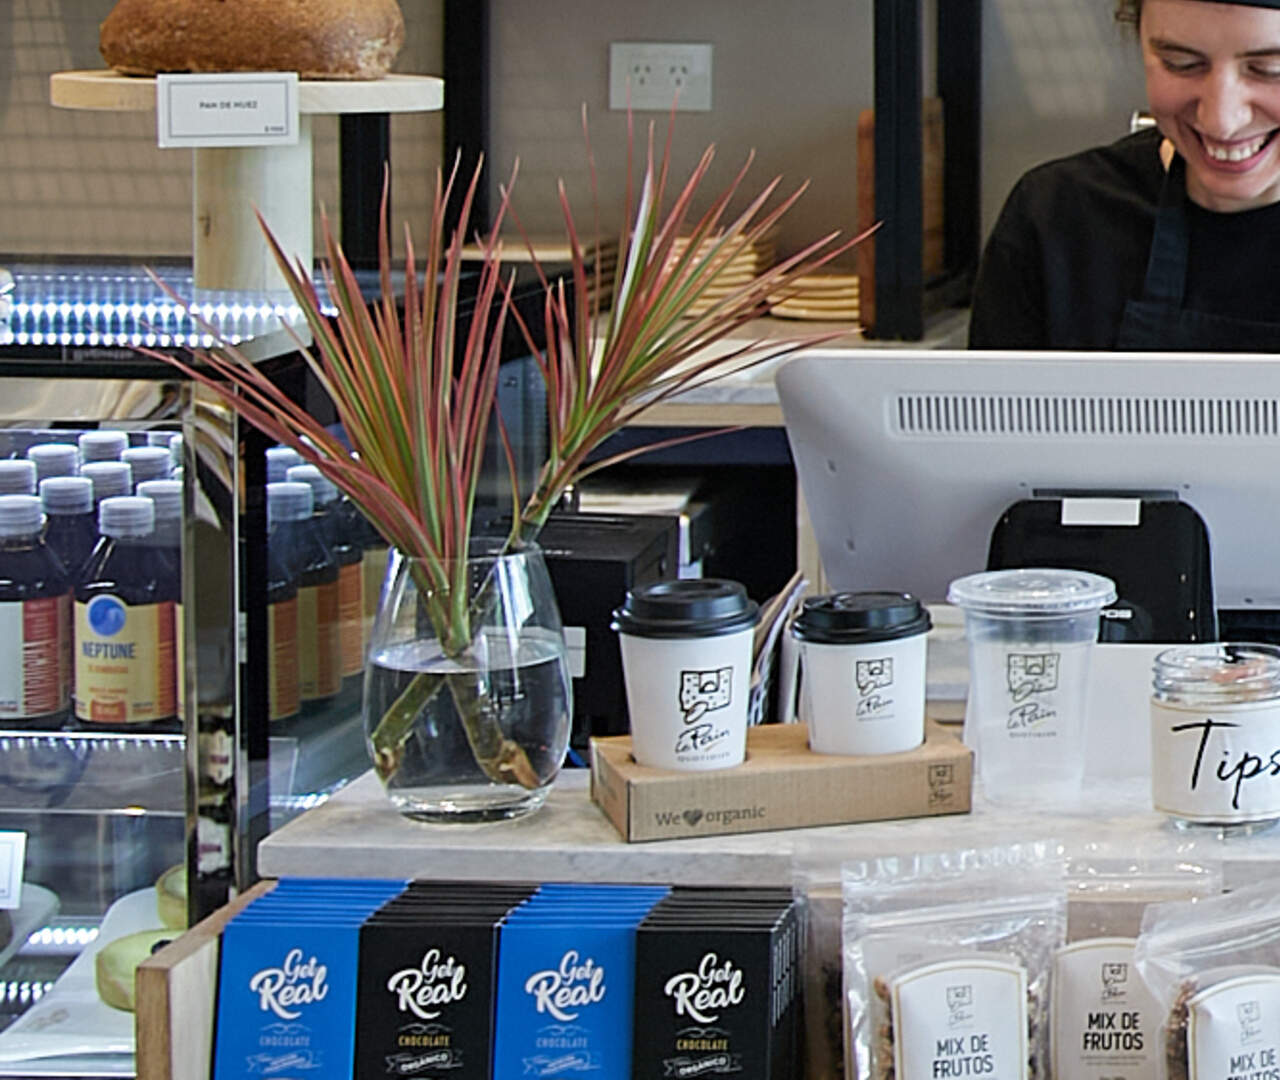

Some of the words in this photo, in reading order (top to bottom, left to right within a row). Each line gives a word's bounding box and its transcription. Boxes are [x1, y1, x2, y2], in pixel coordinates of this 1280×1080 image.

[82, 642, 135, 659] NEPTUNE
[655, 809, 681, 826] We
[705, 806, 766, 825] organic
[250, 965, 329, 1019] Real
[387, 965, 468, 1019] Real
[524, 966, 606, 1022] Real
[664, 969, 746, 1023] Real
[1088, 1012, 1116, 1030] MIX
[1121, 1012, 1140, 1030] DE
[398, 1035, 450, 1047] CHOCOLATE
[676, 1039, 728, 1051] CHOCOLATE
[936, 1037, 965, 1057] MIX
[970, 1034, 990, 1053] DE
[1083, 1032, 1144, 1051] FRUTOS
[933, 1055, 994, 1079] FRUTOS
[1230, 1052, 1256, 1074] MIX
[1260, 1048, 1276, 1068] DE
